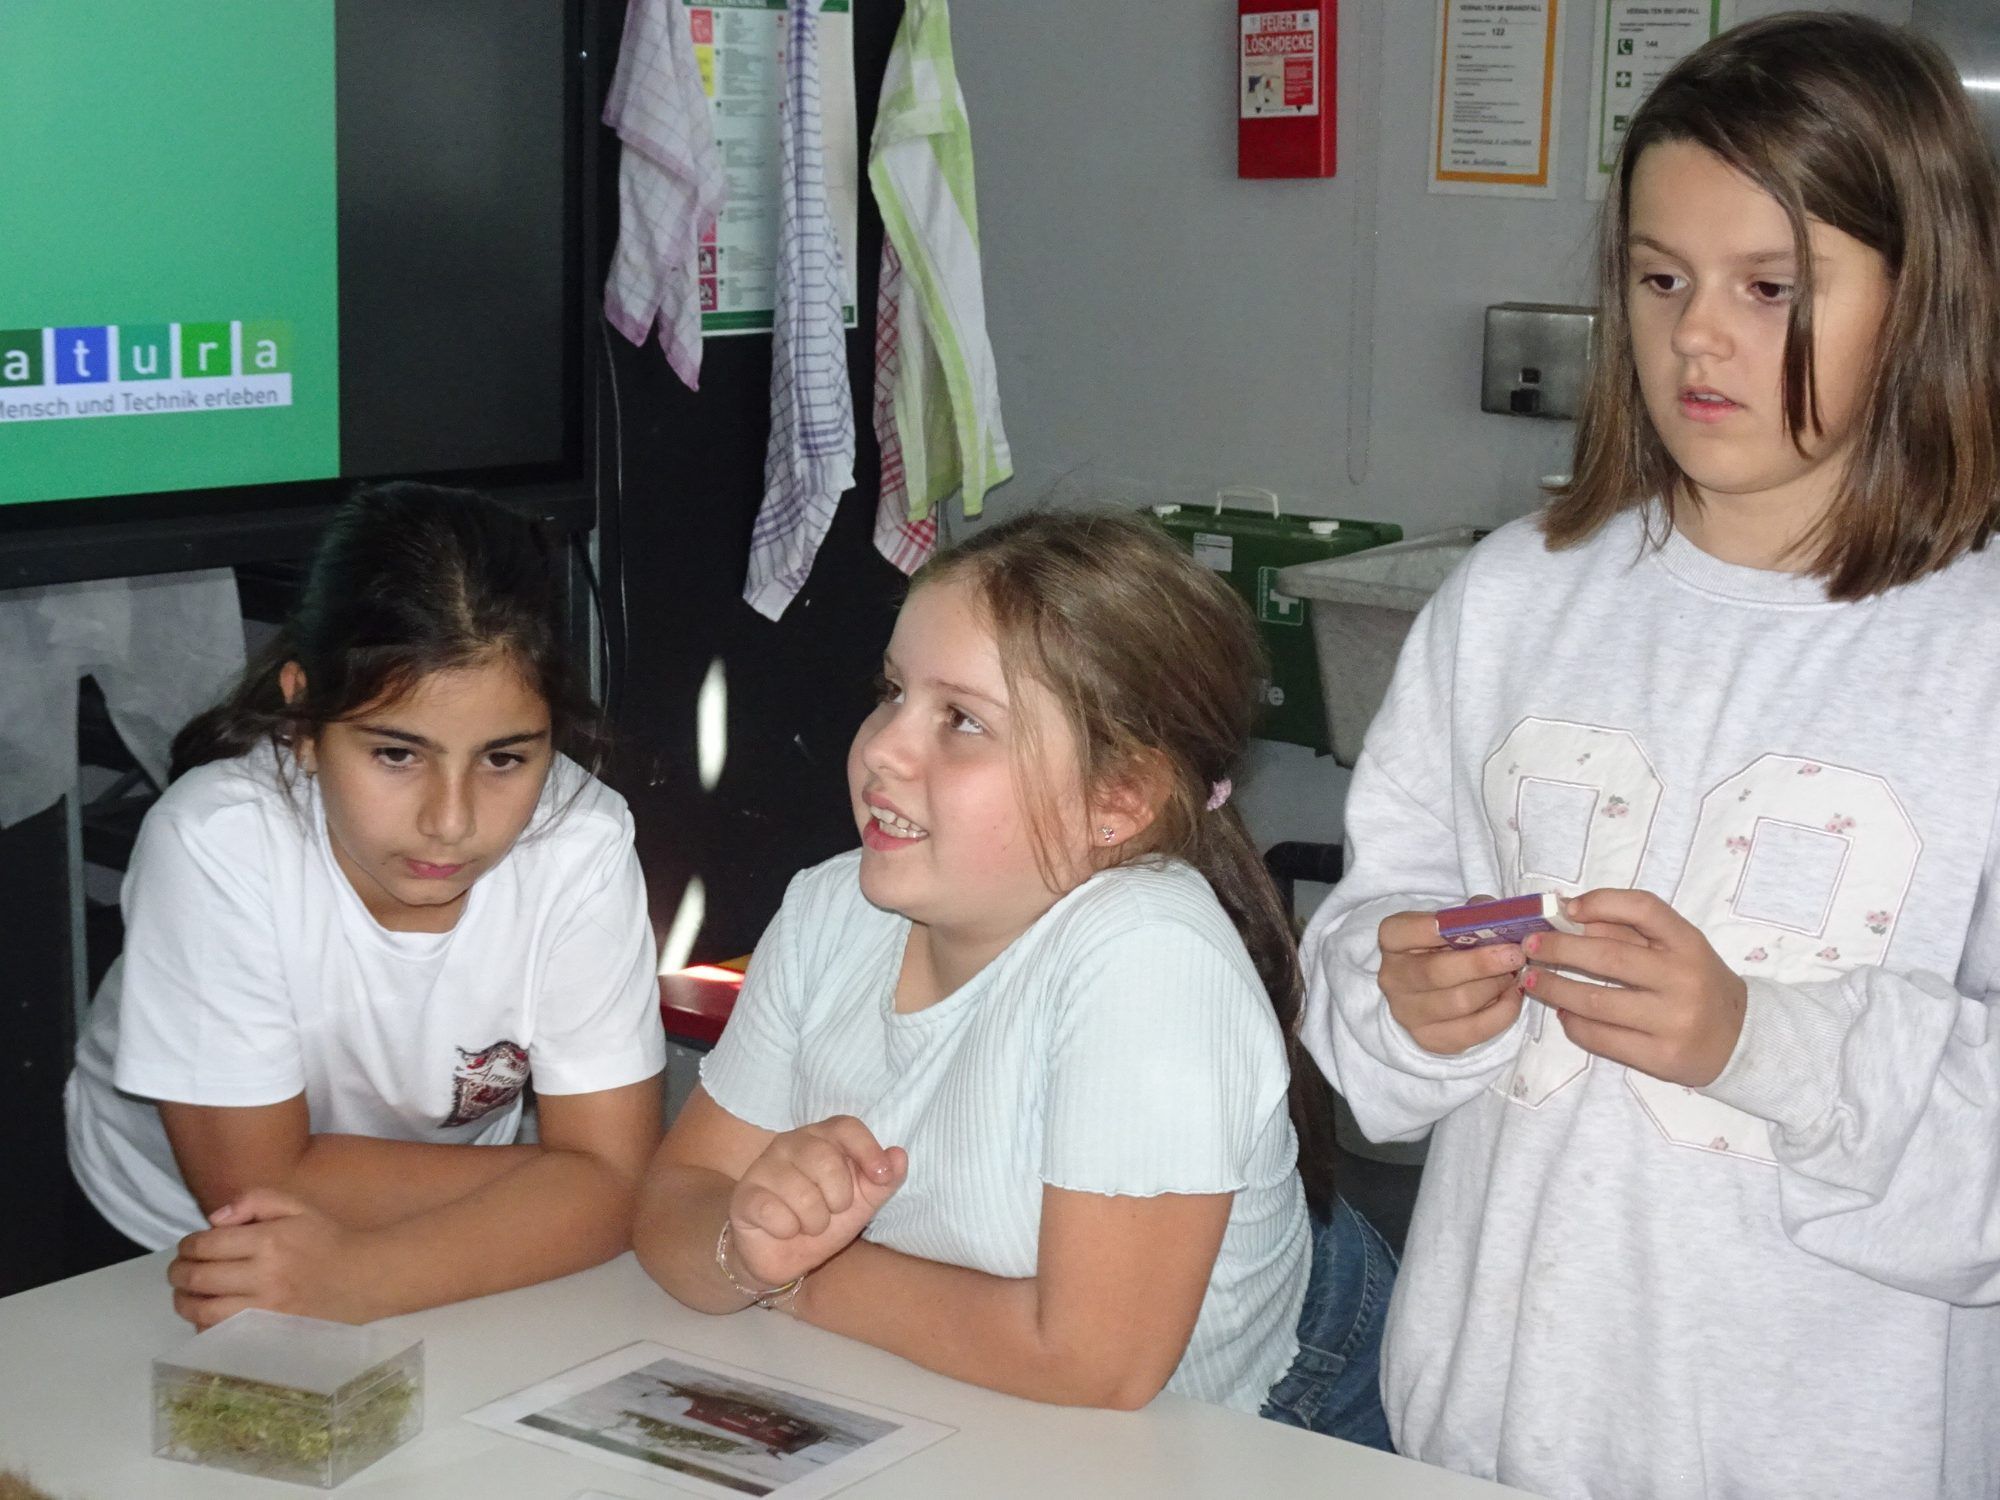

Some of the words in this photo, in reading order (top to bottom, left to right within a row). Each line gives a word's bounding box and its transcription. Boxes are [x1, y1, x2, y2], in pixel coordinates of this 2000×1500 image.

[0, 397, 70, 419] ensch
[75, 395, 115, 414] und
[121, 389, 199, 412] Technik
[204, 385, 279, 407] erleben
